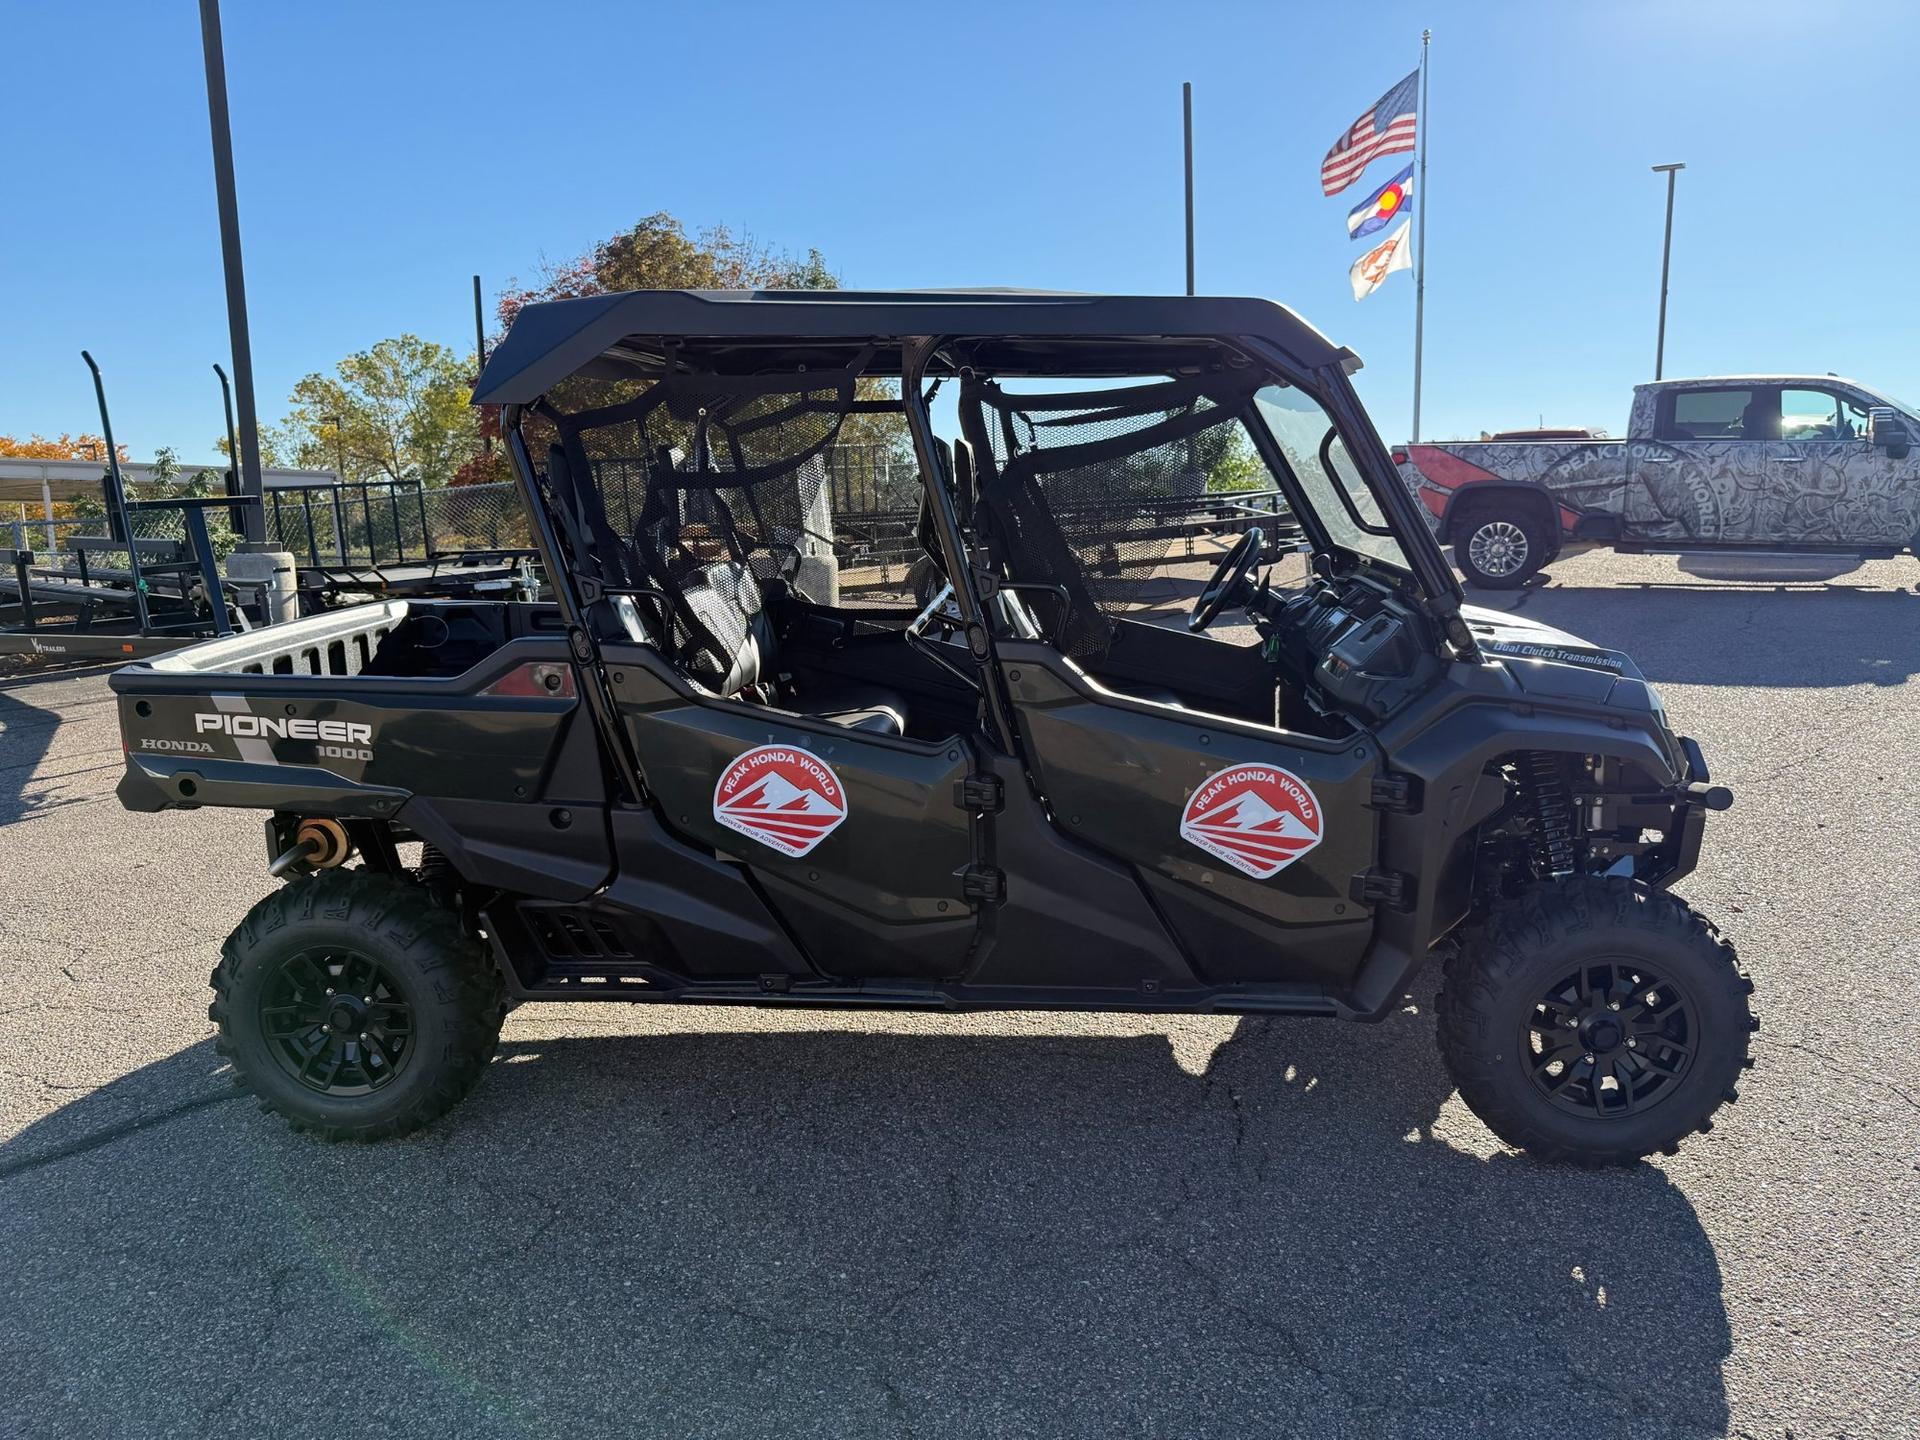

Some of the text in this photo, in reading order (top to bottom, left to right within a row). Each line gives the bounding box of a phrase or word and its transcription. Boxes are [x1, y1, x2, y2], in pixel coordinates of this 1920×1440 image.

[1558, 446, 1612, 478] PEAK
[1685, 471, 1715, 535] WORLD
[1493, 642, 1623, 668] Dual Clutch Transmission
[141, 739, 215, 753] HONDA
[195, 713, 371, 744] PIONEER
[316, 745, 373, 761] 1000
[724, 752, 835, 796] PEAK HONDA WORLD
[1196, 771, 1313, 819] PEAK HONDA WORLD
[719, 815, 796, 854] POWER YOUR ADVENTURE
[1185, 831, 1261, 876] POWER YOUR ADVENTURE
